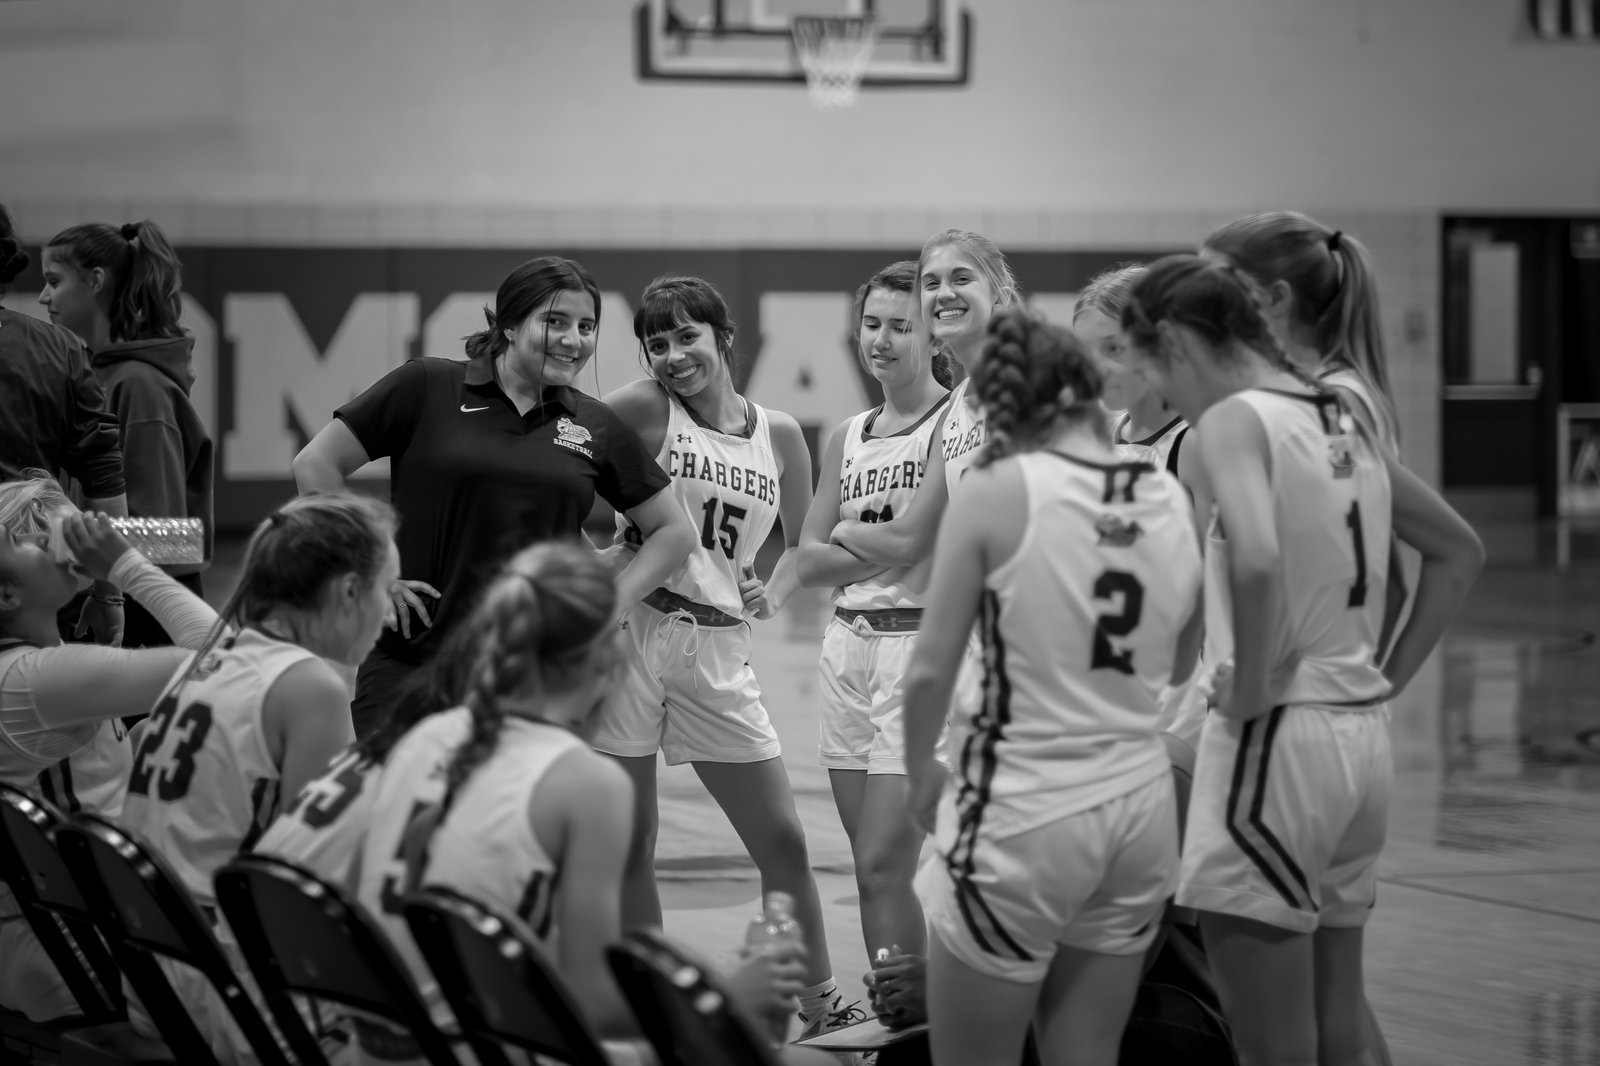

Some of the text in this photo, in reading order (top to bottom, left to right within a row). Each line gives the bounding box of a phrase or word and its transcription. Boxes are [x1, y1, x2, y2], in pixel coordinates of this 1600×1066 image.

[553, 438, 592, 458] BASKETBALL
[670, 449, 775, 506] CHARGERS
[701, 497, 747, 559] 15
[1346, 500, 1367, 608] 1
[1091, 570, 1144, 674] 2
[128, 697, 213, 802] 23
